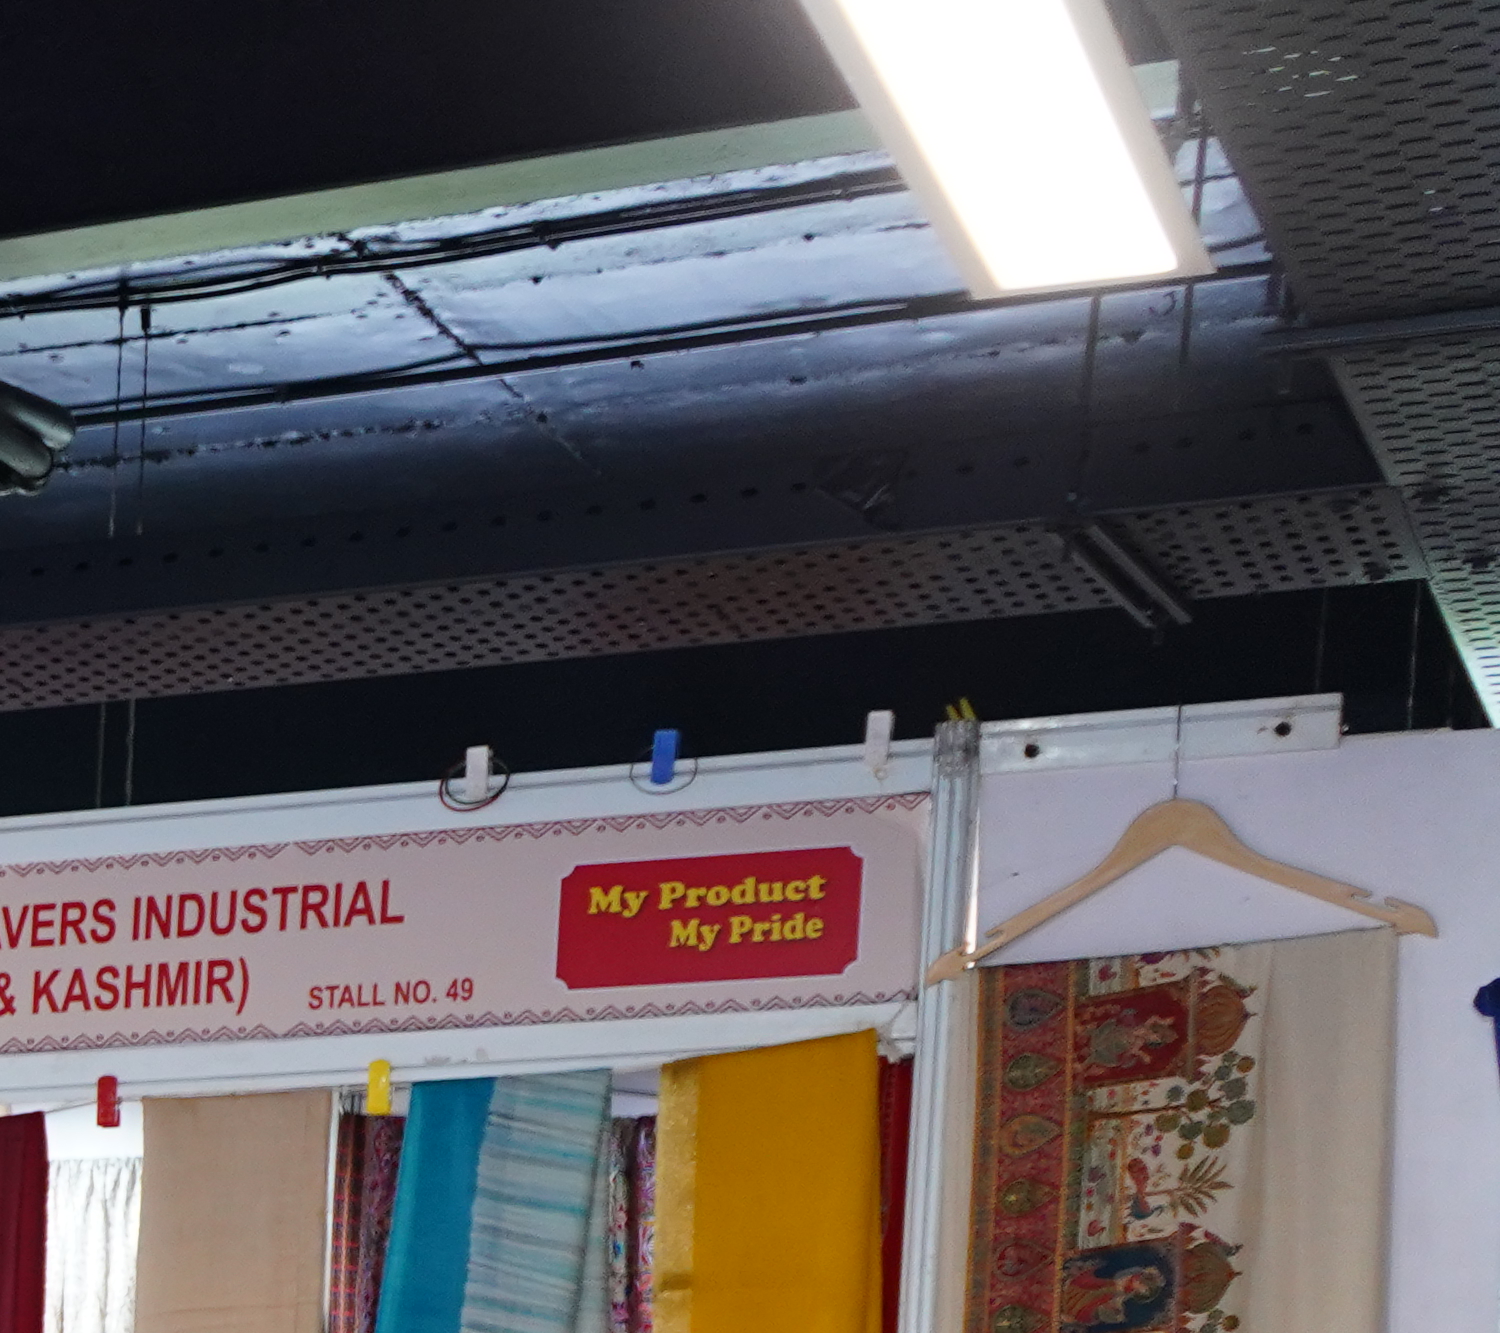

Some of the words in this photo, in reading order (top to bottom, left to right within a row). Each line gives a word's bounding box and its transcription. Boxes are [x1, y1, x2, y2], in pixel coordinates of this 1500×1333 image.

[131, 879, 406, 942] INDUSTRIAL
[588, 886, 647, 917] My
[657, 873, 828, 911] Product
[669, 920, 721, 951] My
[727, 912, 824, 944] Pride
[31, 957, 250, 1014] KASHMIR)
[307, 982, 391, 1010] STALL
[393, 980, 439, 1005] NO.
[445, 978, 474, 1002] 49
